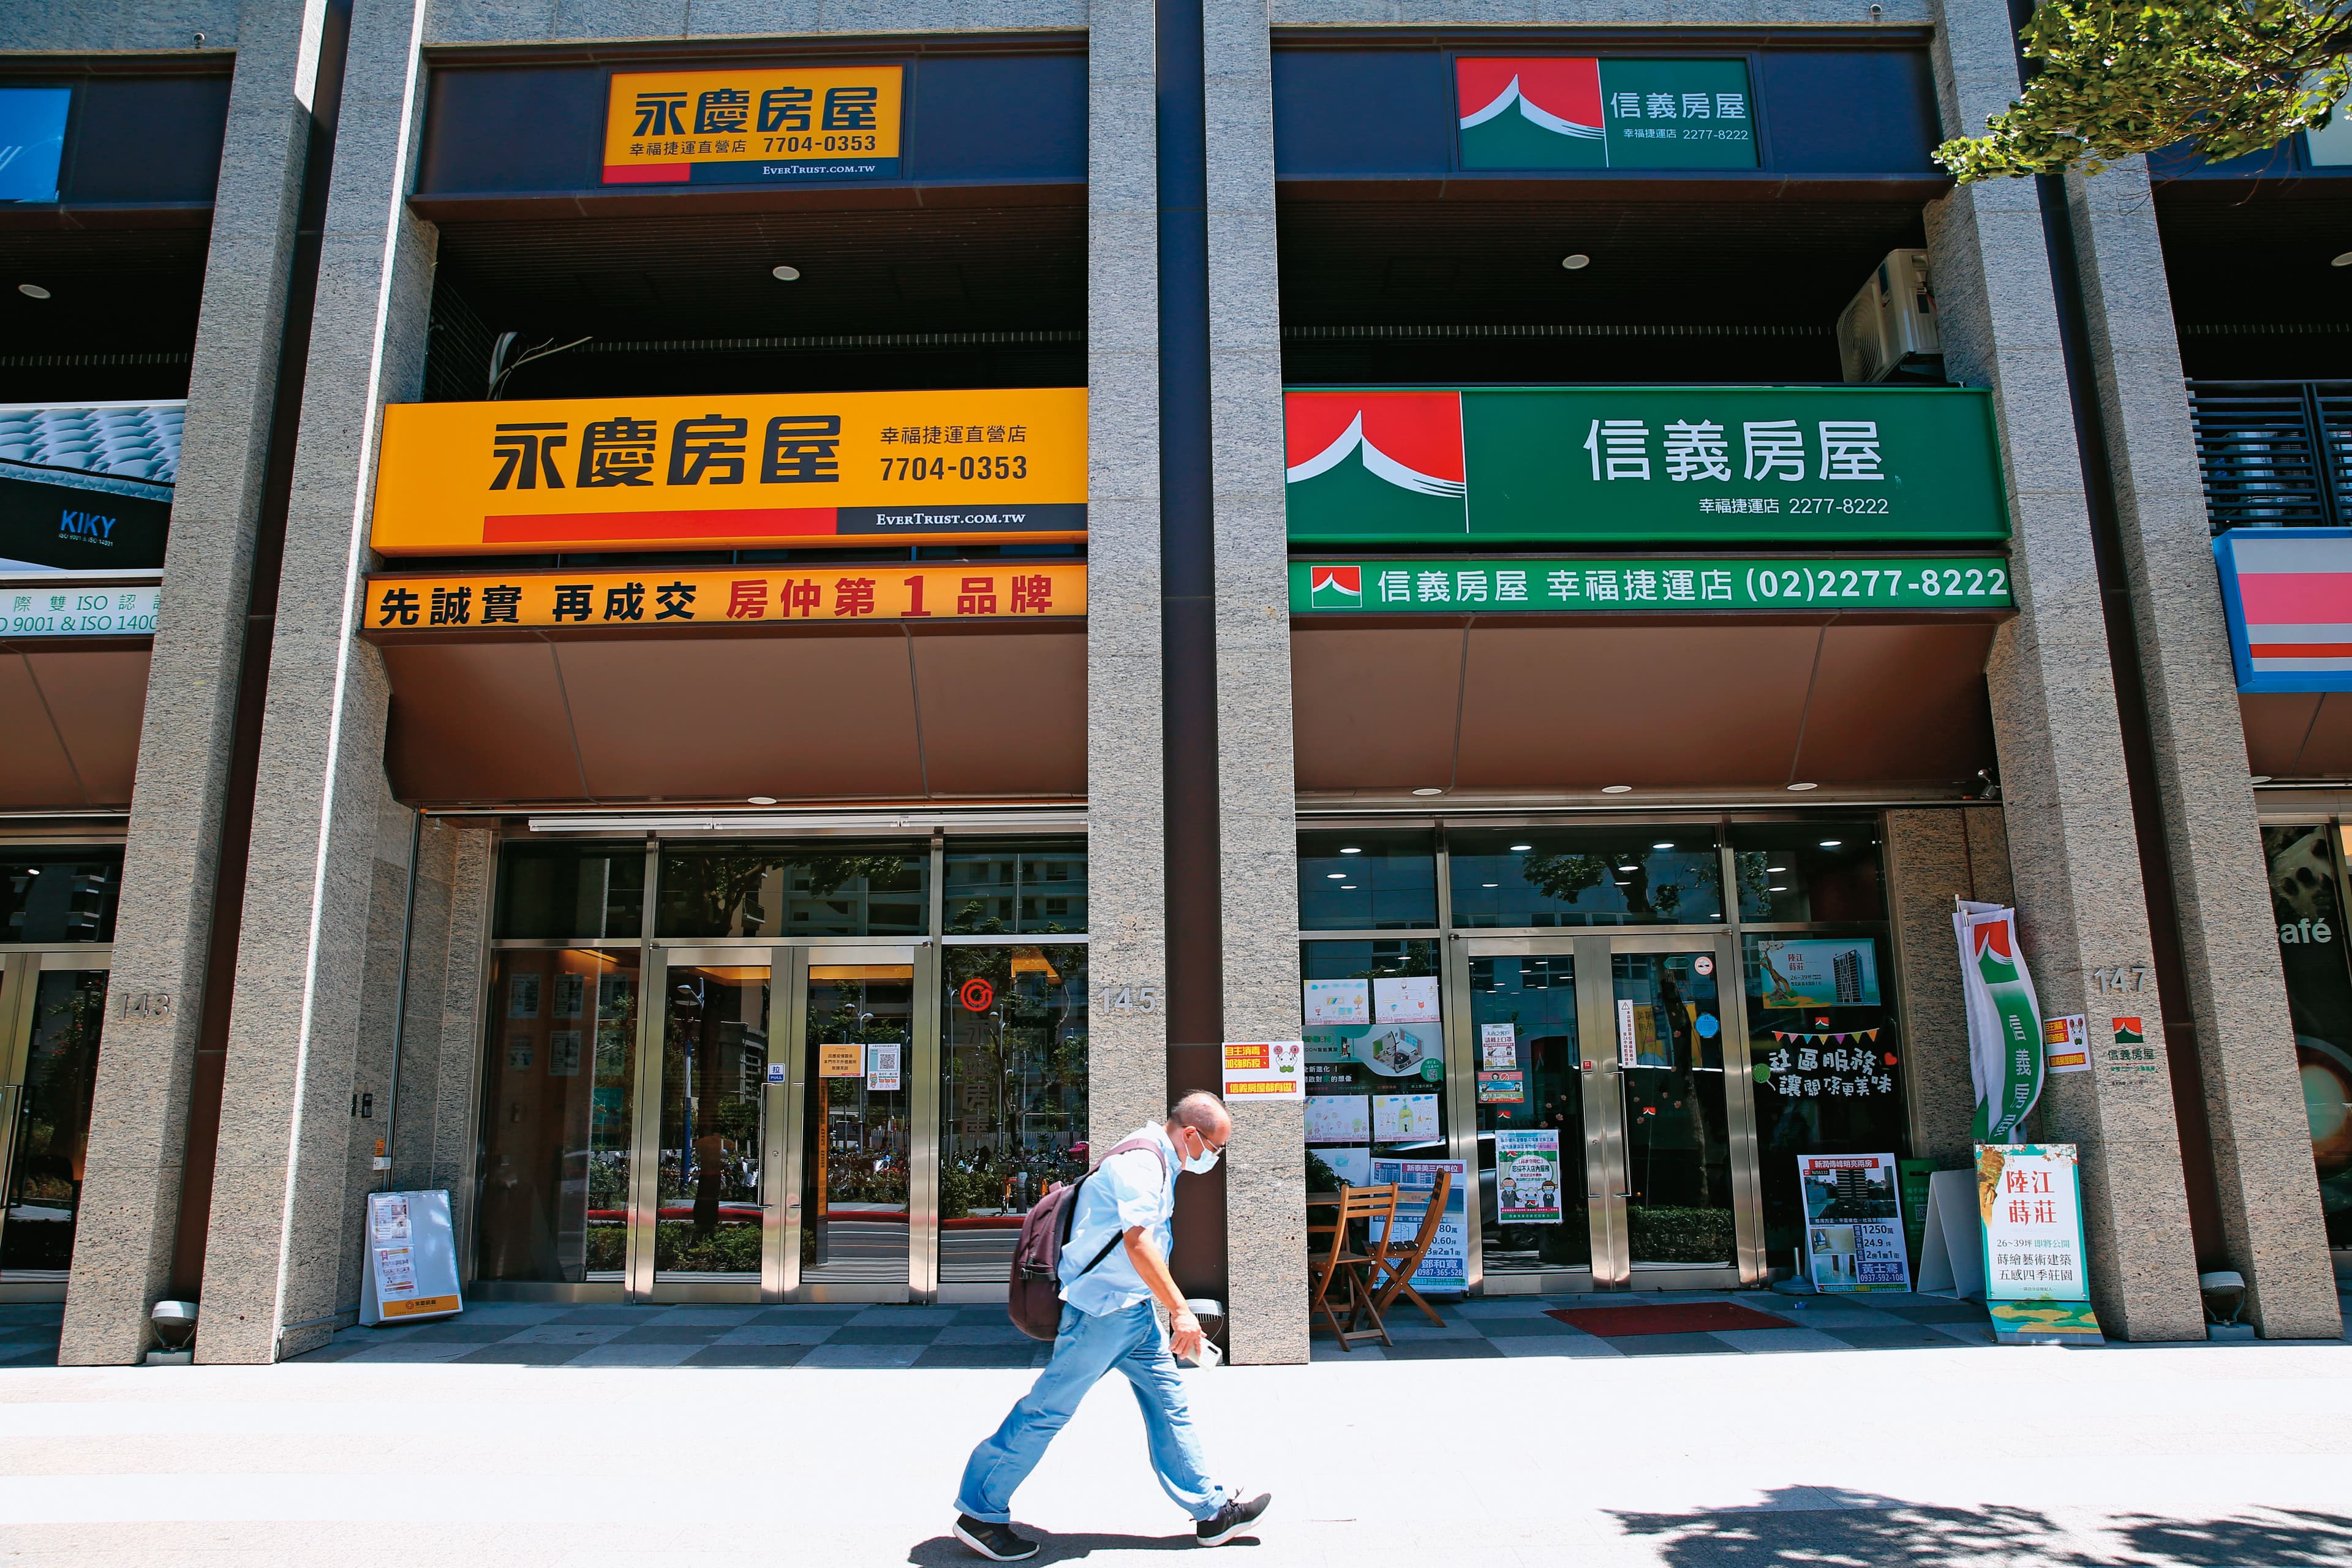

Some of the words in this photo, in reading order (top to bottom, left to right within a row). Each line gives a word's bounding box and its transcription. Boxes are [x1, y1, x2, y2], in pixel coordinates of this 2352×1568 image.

[633, 86, 878, 137] 永慶房屋
[1610, 92, 1746, 119] 信義房屋
[630, 140, 747, 156] 幸福捷運直營店
[764, 136, 876, 153] 7704-0353
[1623, 129, 1677, 138] 幸福捷運店
[1683, 129, 1749, 140] 2277-8222
[880, 424, 1027, 445] 幸福捷運直營店
[489, 414, 840, 490] 永慶房屋
[1583, 418, 1885, 483] 信義房屋
[880, 455, 1028, 481] 7704-0353
[1699, 497, 1780, 515] 幸福捷運店
[1789, 497, 1889, 515] 2277-8222
[61, 510, 116, 538] KIKY
[1378, 570, 1529, 603] 信義房屋
[1547, 568, 1733, 602] 幸福捷運店
[1746, 567, 2008, 603] (02)2277-8222
[379, 584, 524, 628] 先誠實
[552, 582, 698, 621] 再成交
[726, 574, 1054, 618] 房仲第1品牌
[13, 617, 55, 632] 9001
[61, 616, 75, 631] &
[80, 616, 111, 630] ISO
[117, 615, 158, 630] 1400
[2280, 918, 2332, 943] afé
[2094, 967, 2147, 993] 147
[115, 994, 170, 1019] 143
[1098, 987, 1156, 1013] 145
[1768, 1047, 1877, 1076] 社區服務
[2108, 1049, 2155, 1060] 信義房屋
[1779, 1074, 1891, 1096] 讓關係更美味
[2007, 1170, 2055, 1194] 陸江
[2009, 1200, 2057, 1226] 蒔莊
[1433, 1237, 1457, 1245] 0.60坪
[1439, 1224, 1458, 1234] 80萬
[1863, 1225, 1894, 1234] 1250萬
[1997, 1239, 2032, 1248] 26~39坪
[2035, 1239, 2070, 1248] 即將公開
[1997, 1253, 2071, 1265] 蒔繪藝術建築
[1860, 1273, 1904, 1282] 0937-592-108
[1999, 1269, 2073, 1281] 五感四季莊園
